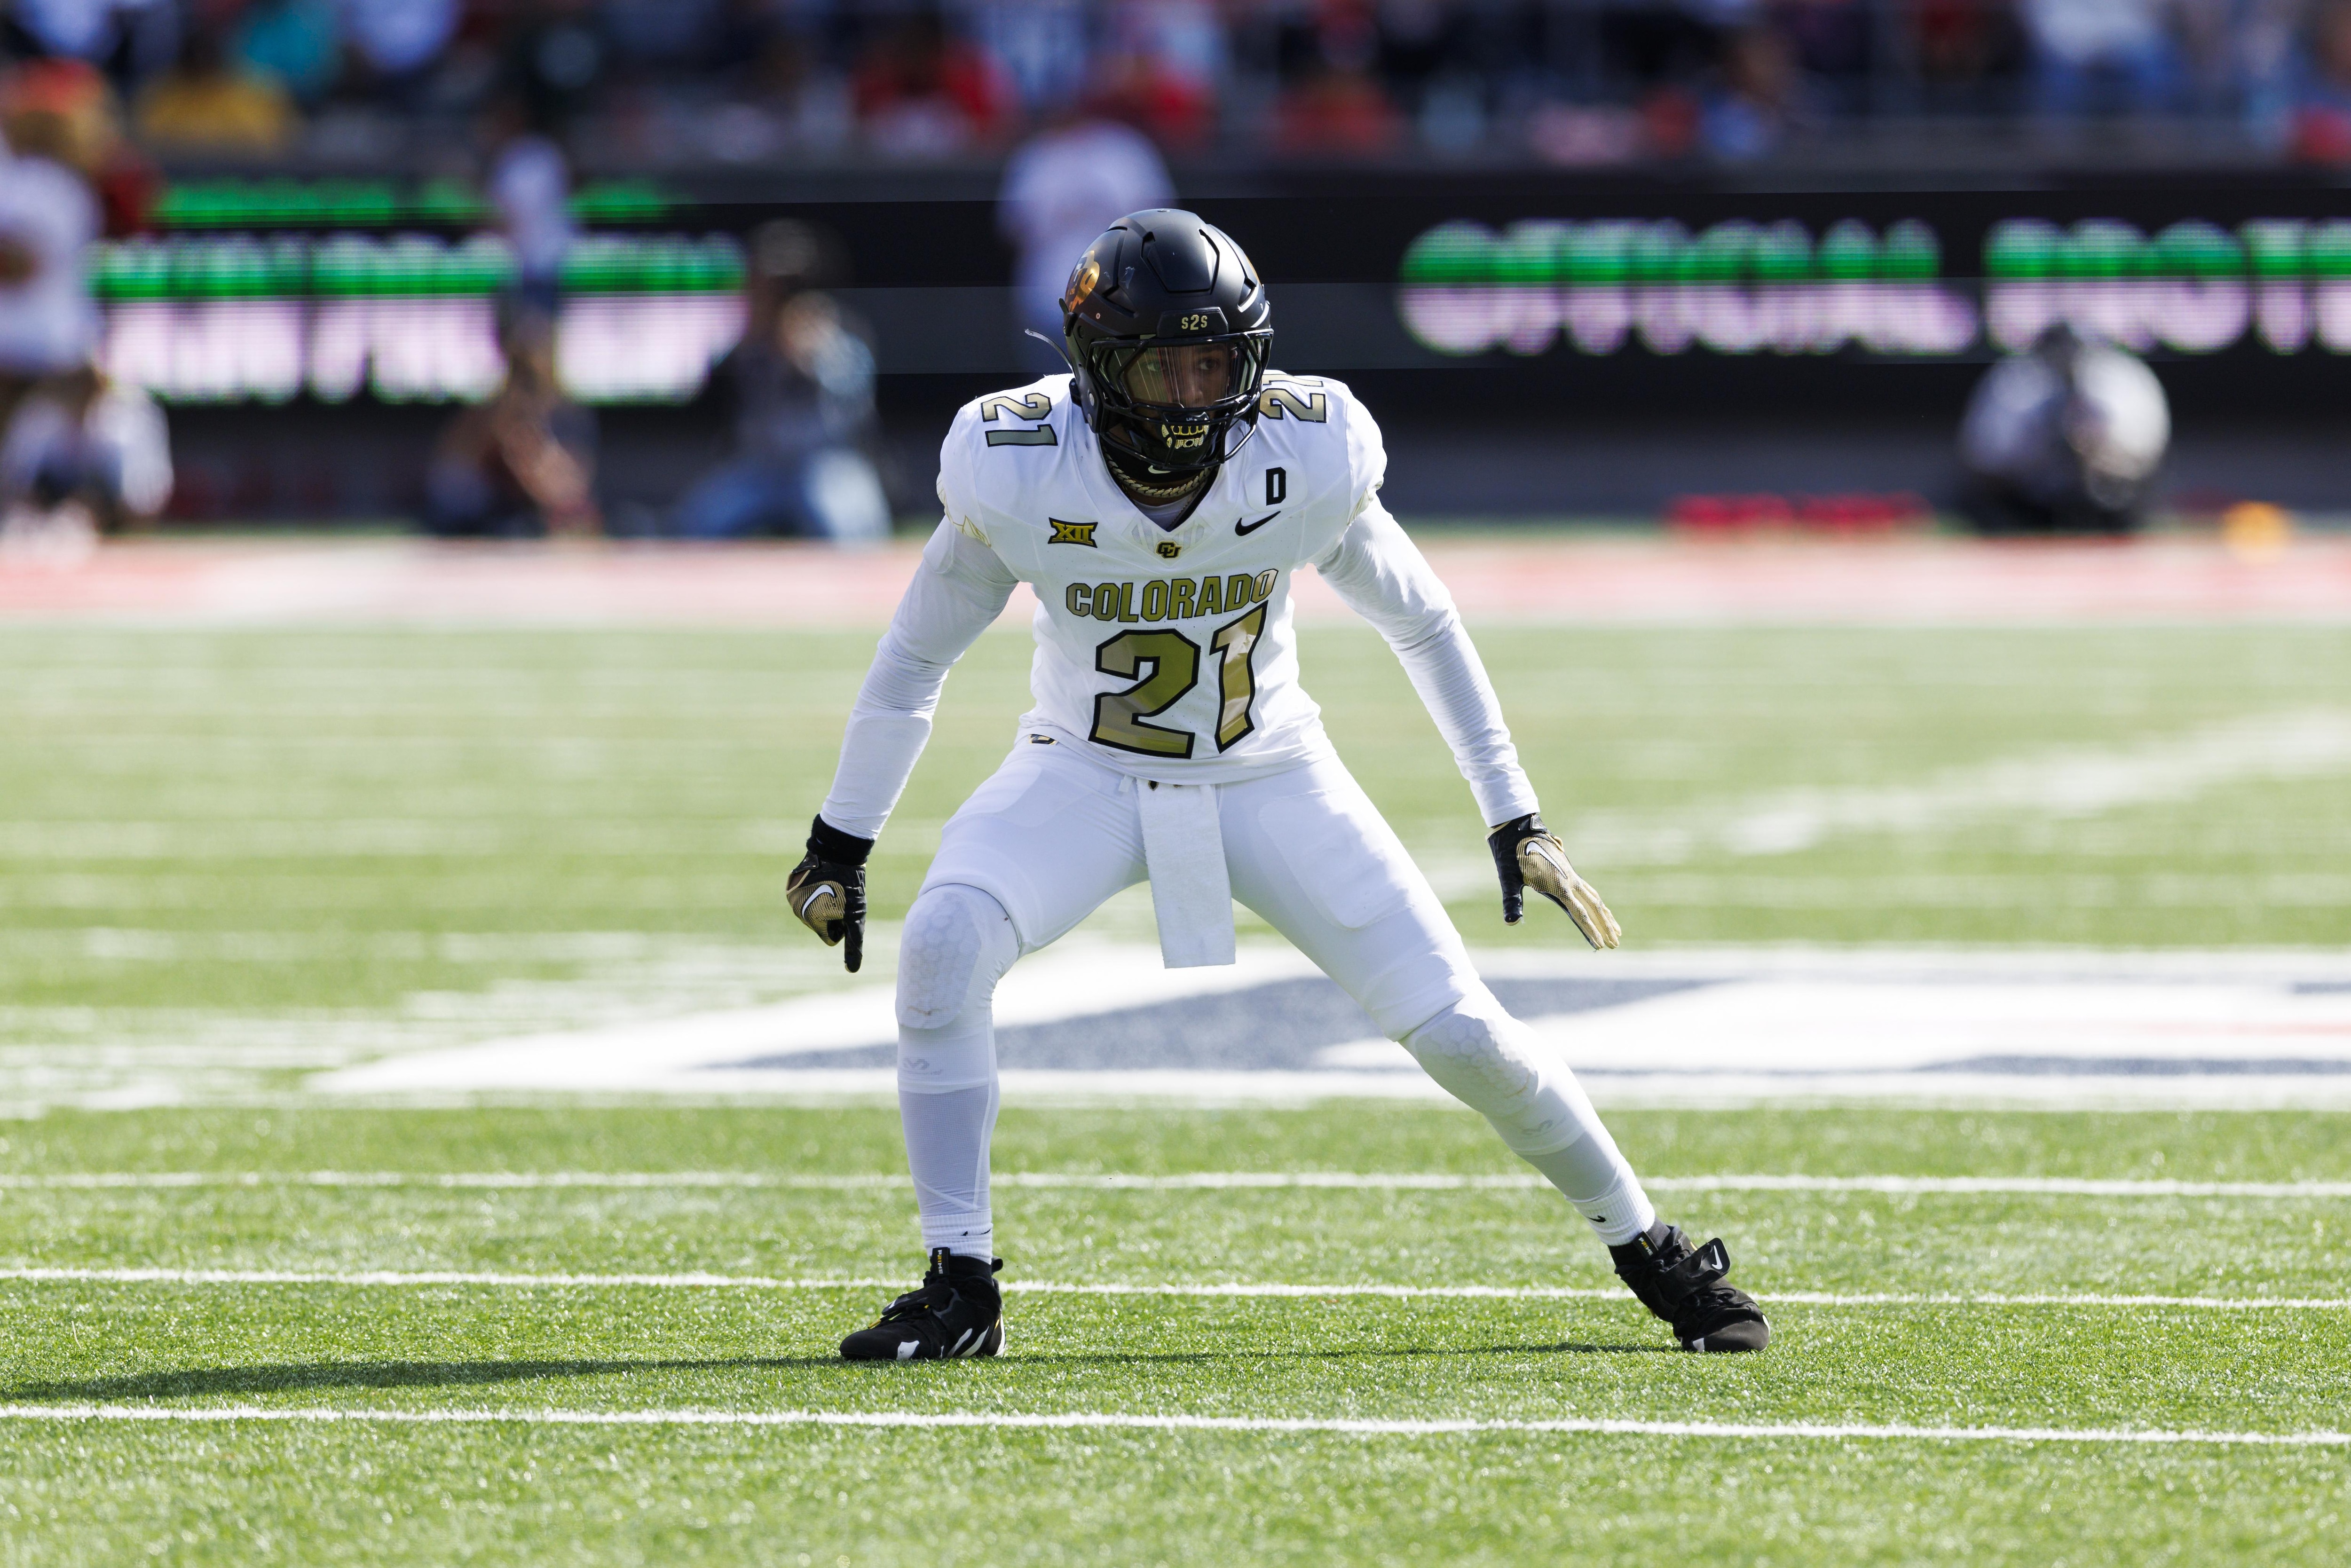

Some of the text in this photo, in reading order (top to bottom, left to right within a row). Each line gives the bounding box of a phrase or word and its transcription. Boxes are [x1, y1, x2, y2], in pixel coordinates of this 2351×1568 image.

[1181, 314, 1208, 331] S2S
[980, 393, 1058, 448] 21
[1259, 373, 1327, 423] 21
[1266, 466, 1286, 506] D
[1066, 568, 1279, 622] COLORADO
[1088, 600, 1269, 759] 21
